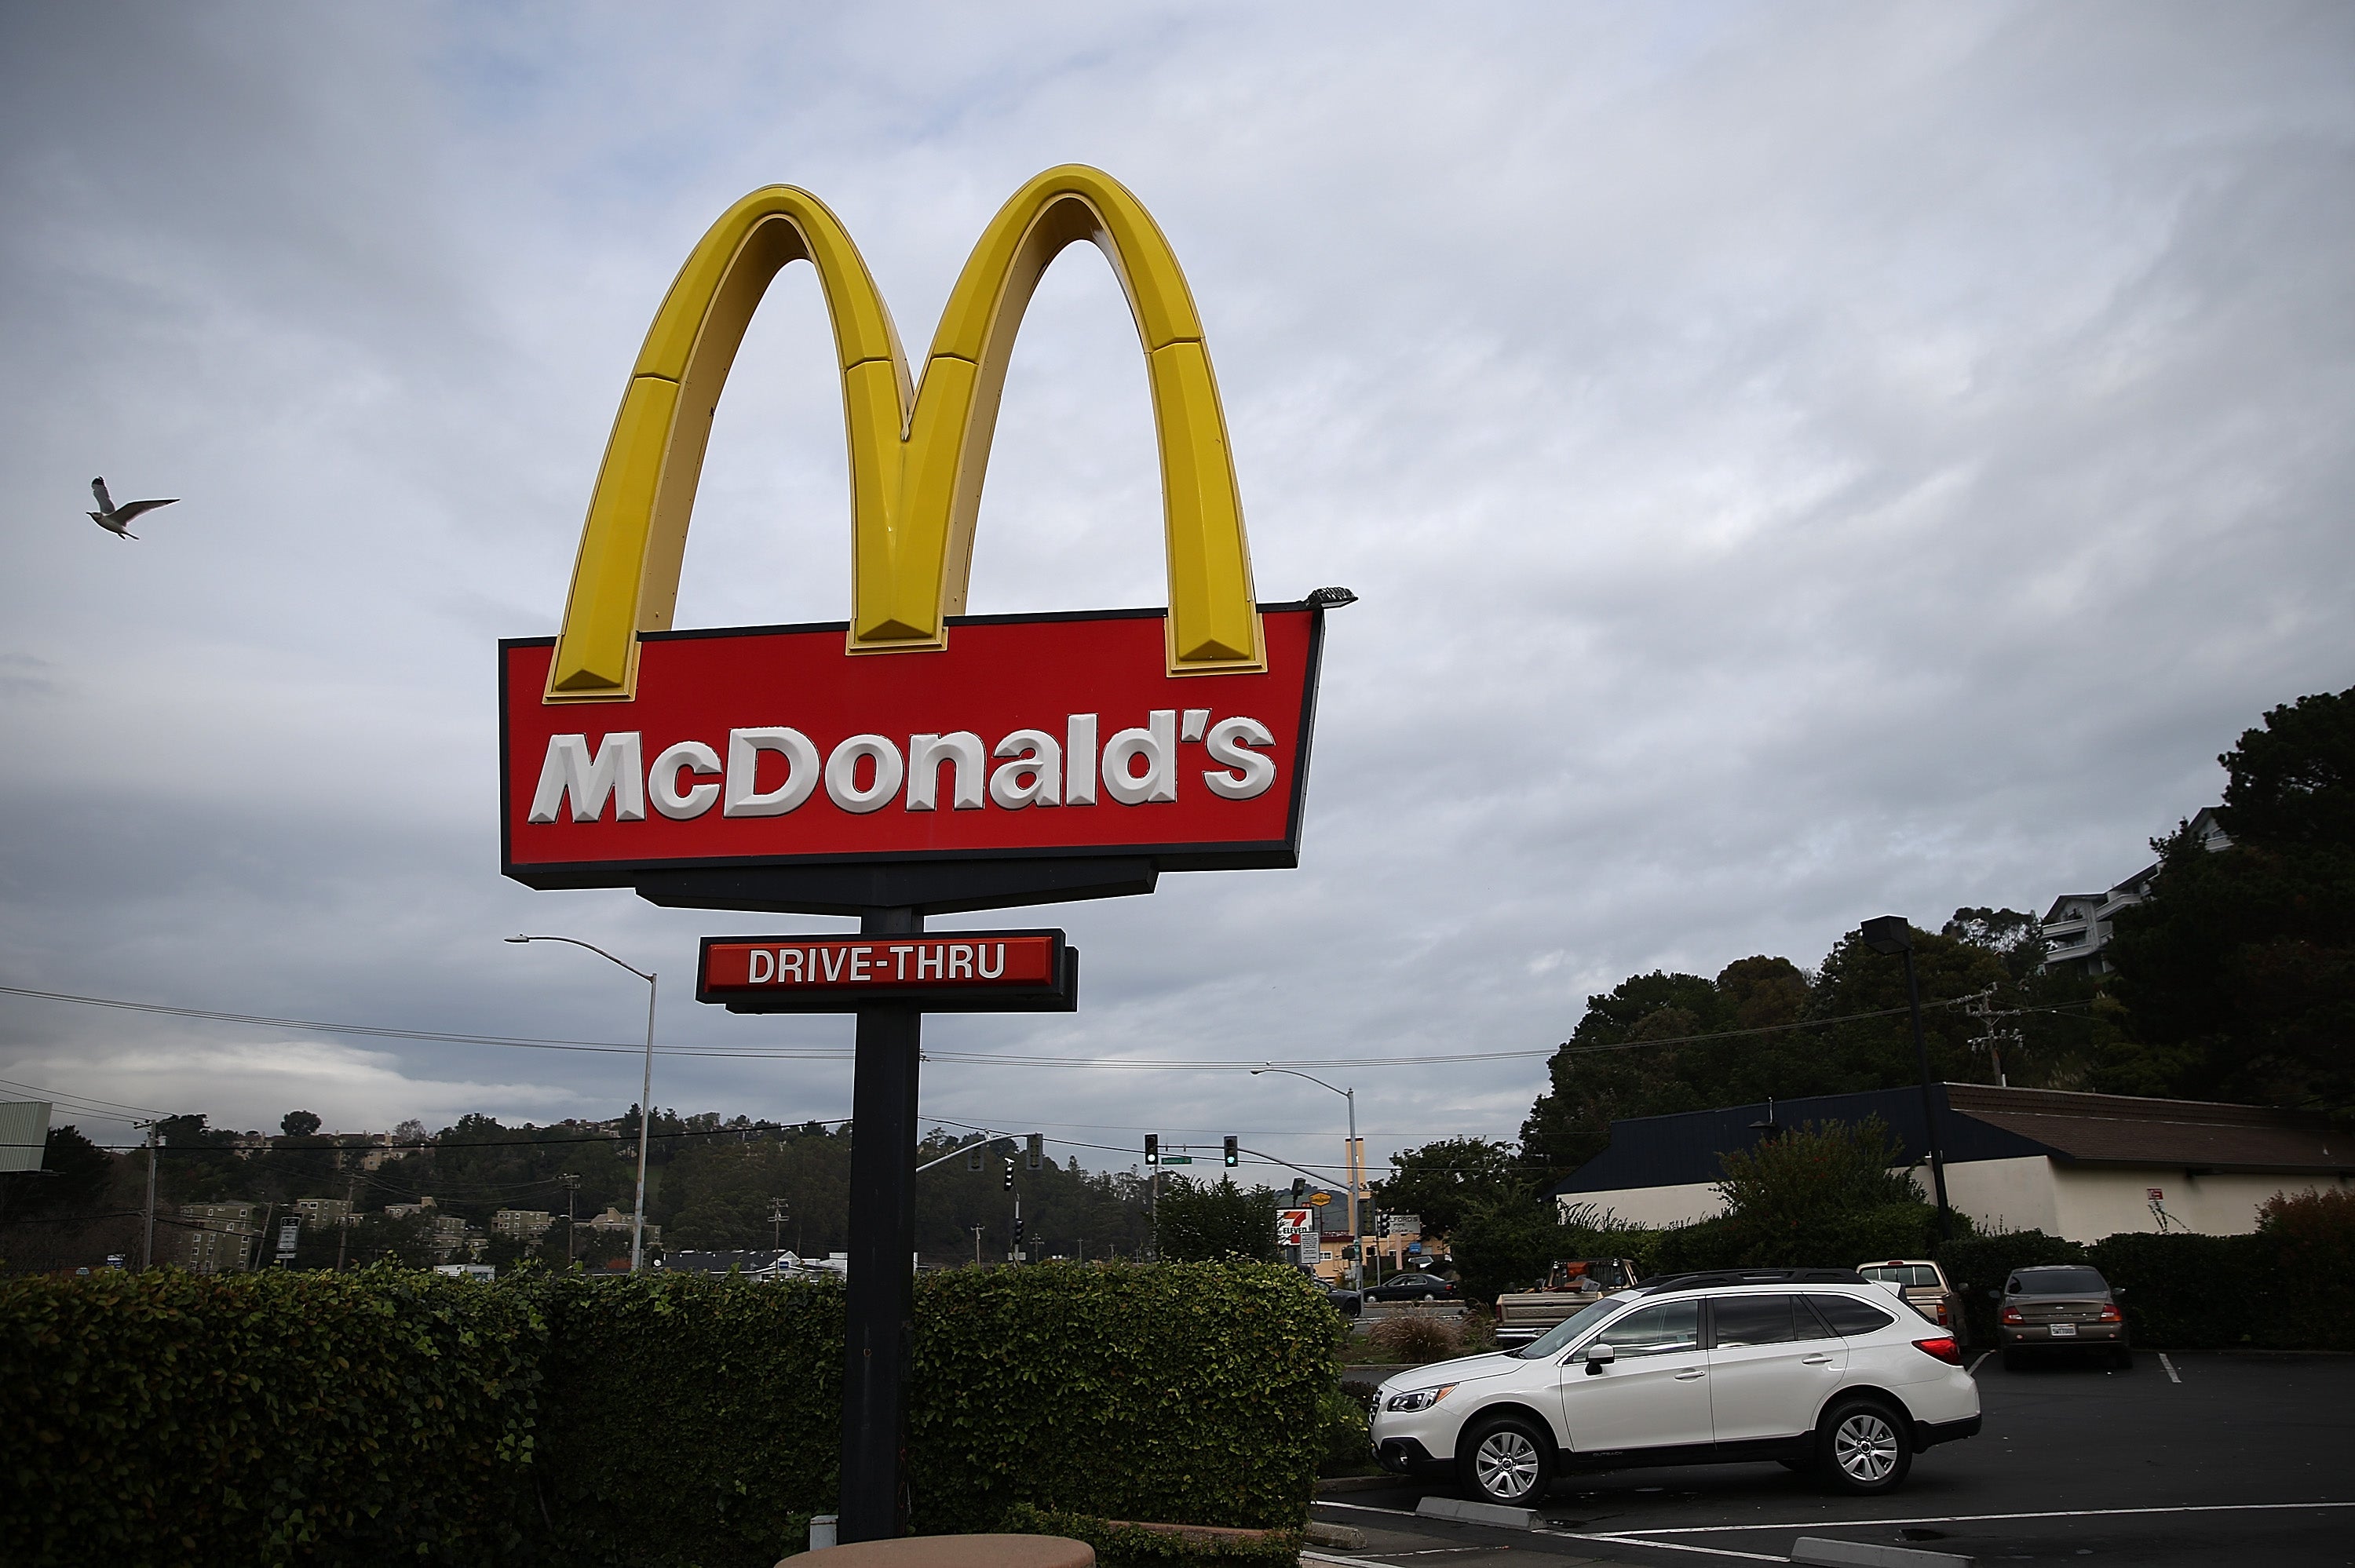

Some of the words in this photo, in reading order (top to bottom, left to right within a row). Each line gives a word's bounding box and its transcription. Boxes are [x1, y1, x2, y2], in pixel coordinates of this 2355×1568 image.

[528, 708, 1277, 824] McDonald's
[748, 943, 1006, 984] DRIVE-THRU
[1283, 1211, 1306, 1244] 7
